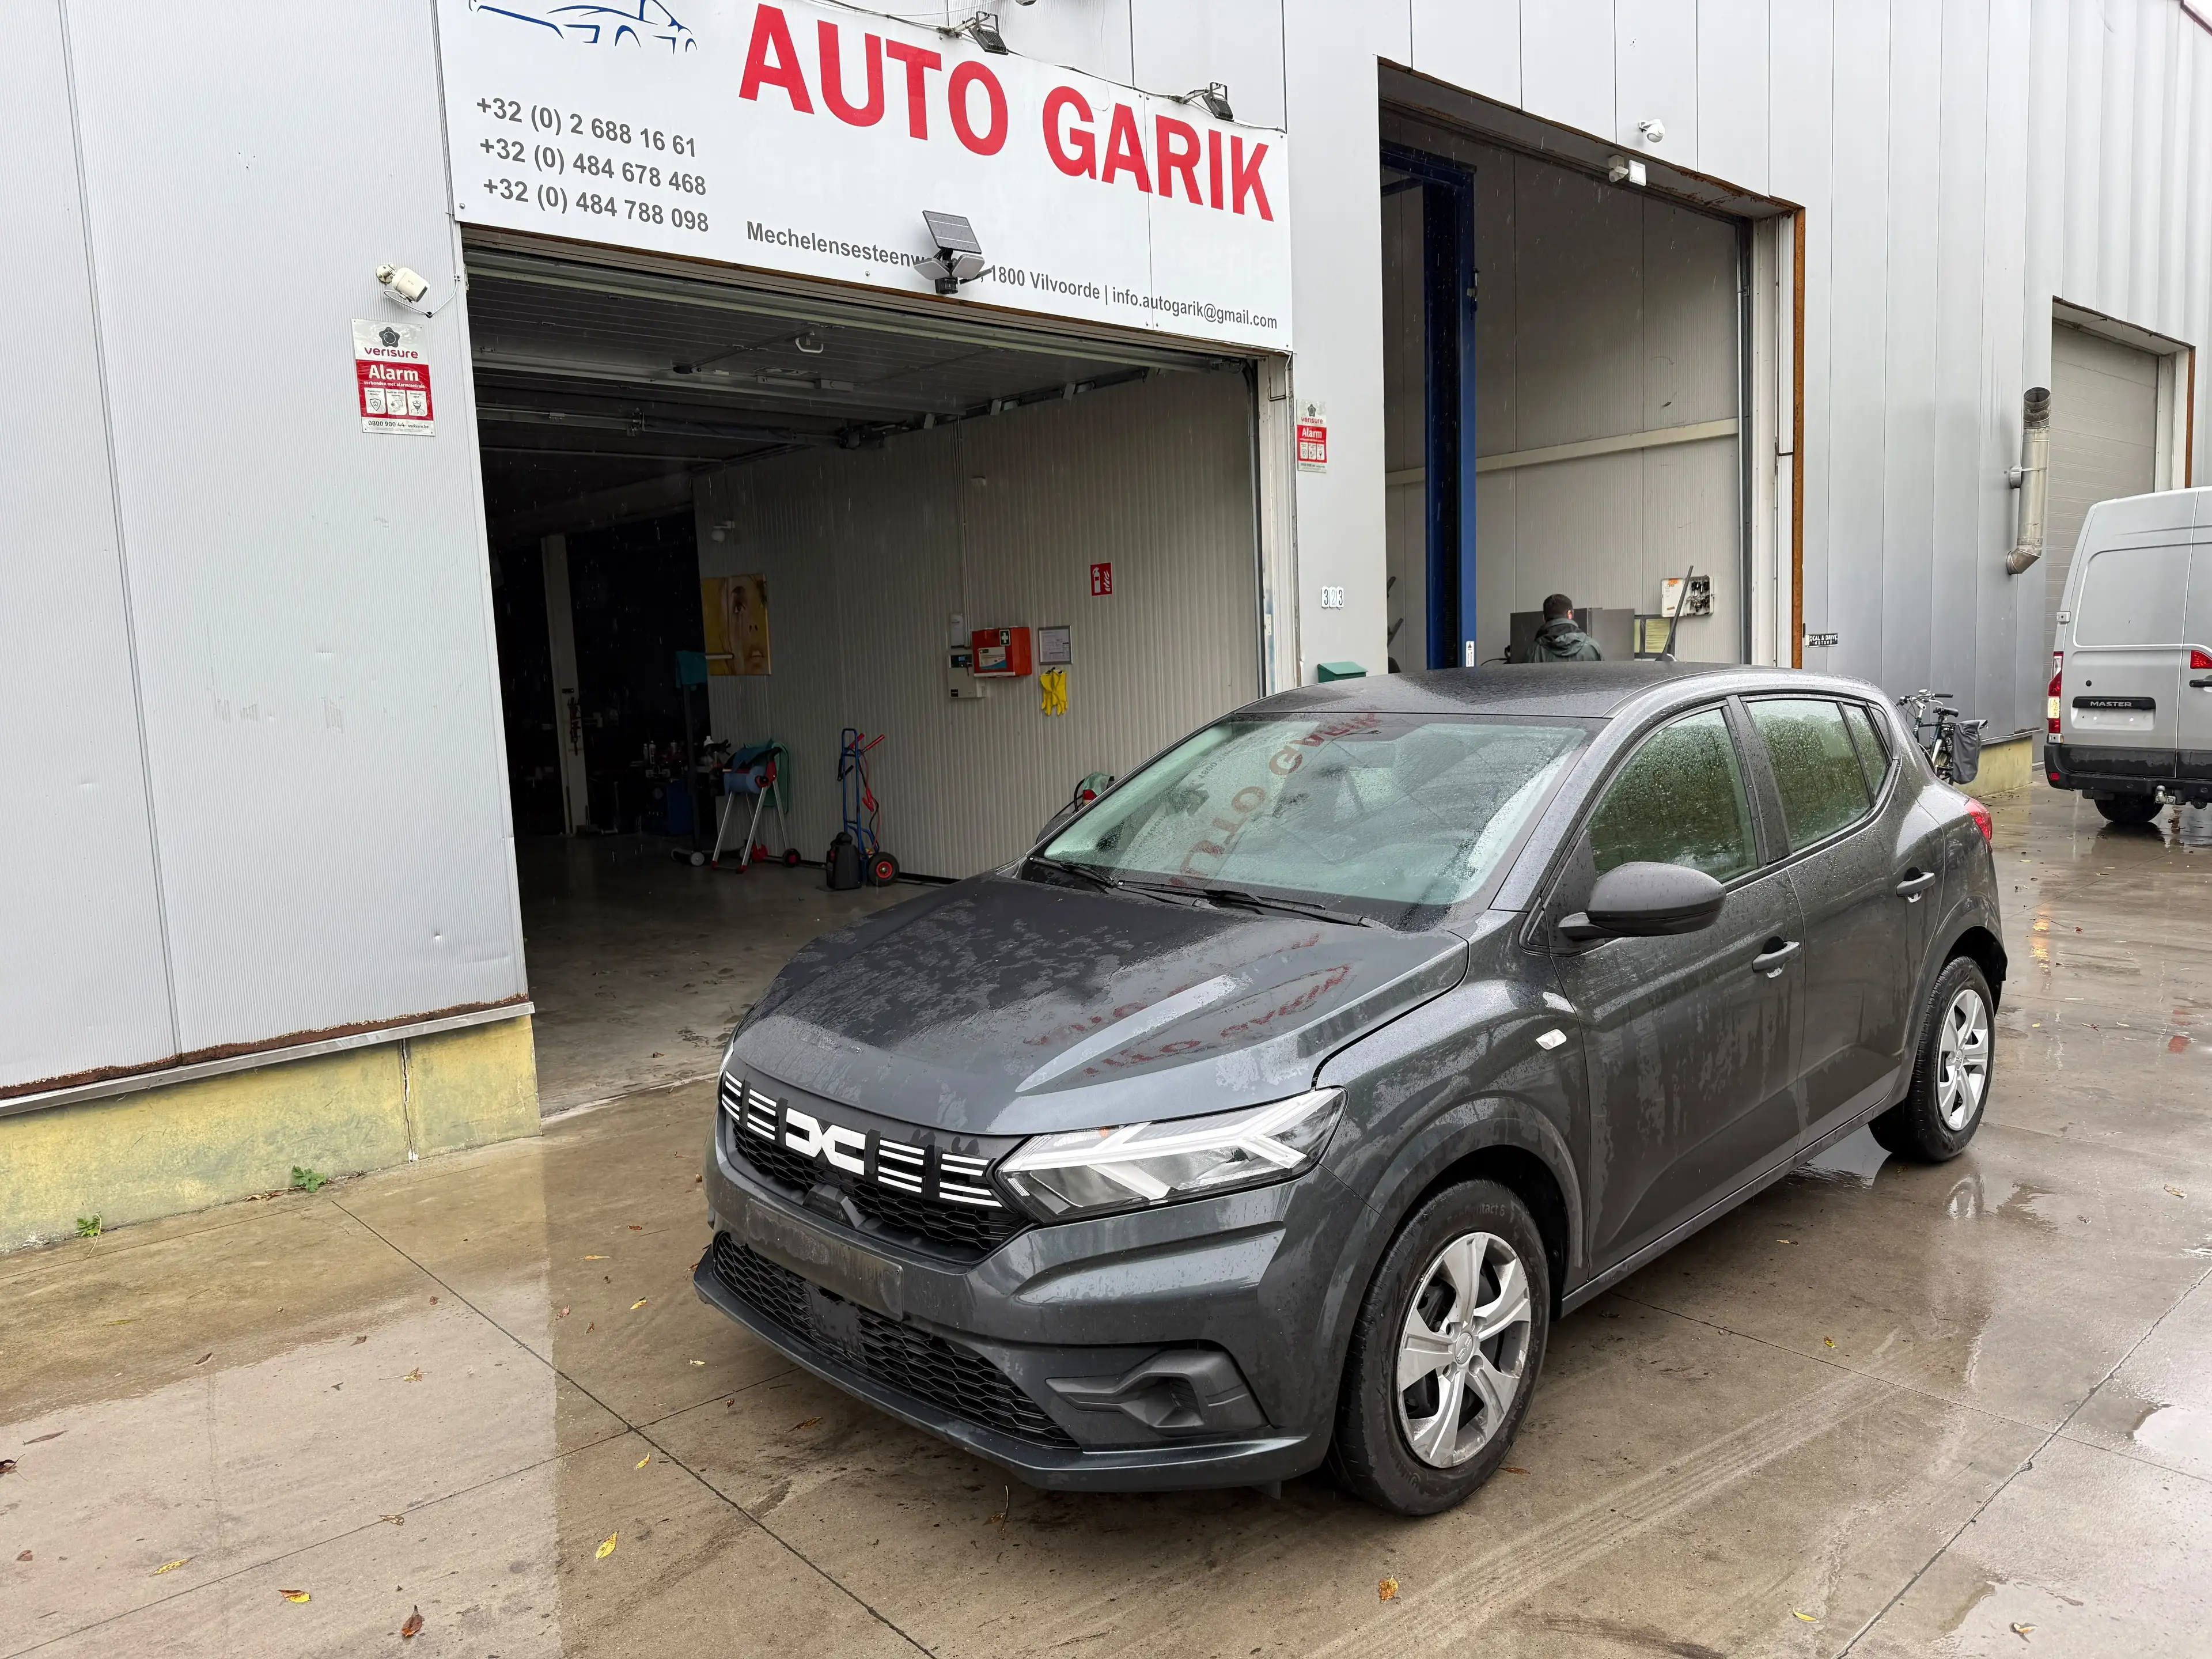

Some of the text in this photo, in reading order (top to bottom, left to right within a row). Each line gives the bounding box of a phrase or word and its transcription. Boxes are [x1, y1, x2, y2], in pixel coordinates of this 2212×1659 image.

[476, 97, 695, 157] +32 (0) 2 688 16 61
[740, 3, 1274, 222] AUTO GARIK
[480, 138, 706, 195] +32 (0) 484 678 468
[483, 179, 709, 232] +32 (0) 484 788 098
[992, 264, 1025, 286] 1800
[1029, 271, 1100, 300] Vilvoorde
[1113, 286, 1277, 329] info.autogarik@gmail.com
[364, 347, 418, 359] verisure
[369, 364, 419, 381] Alarm
[1302, 427, 1322, 438] Alarm
[1324, 589, 1343, 605] 323
